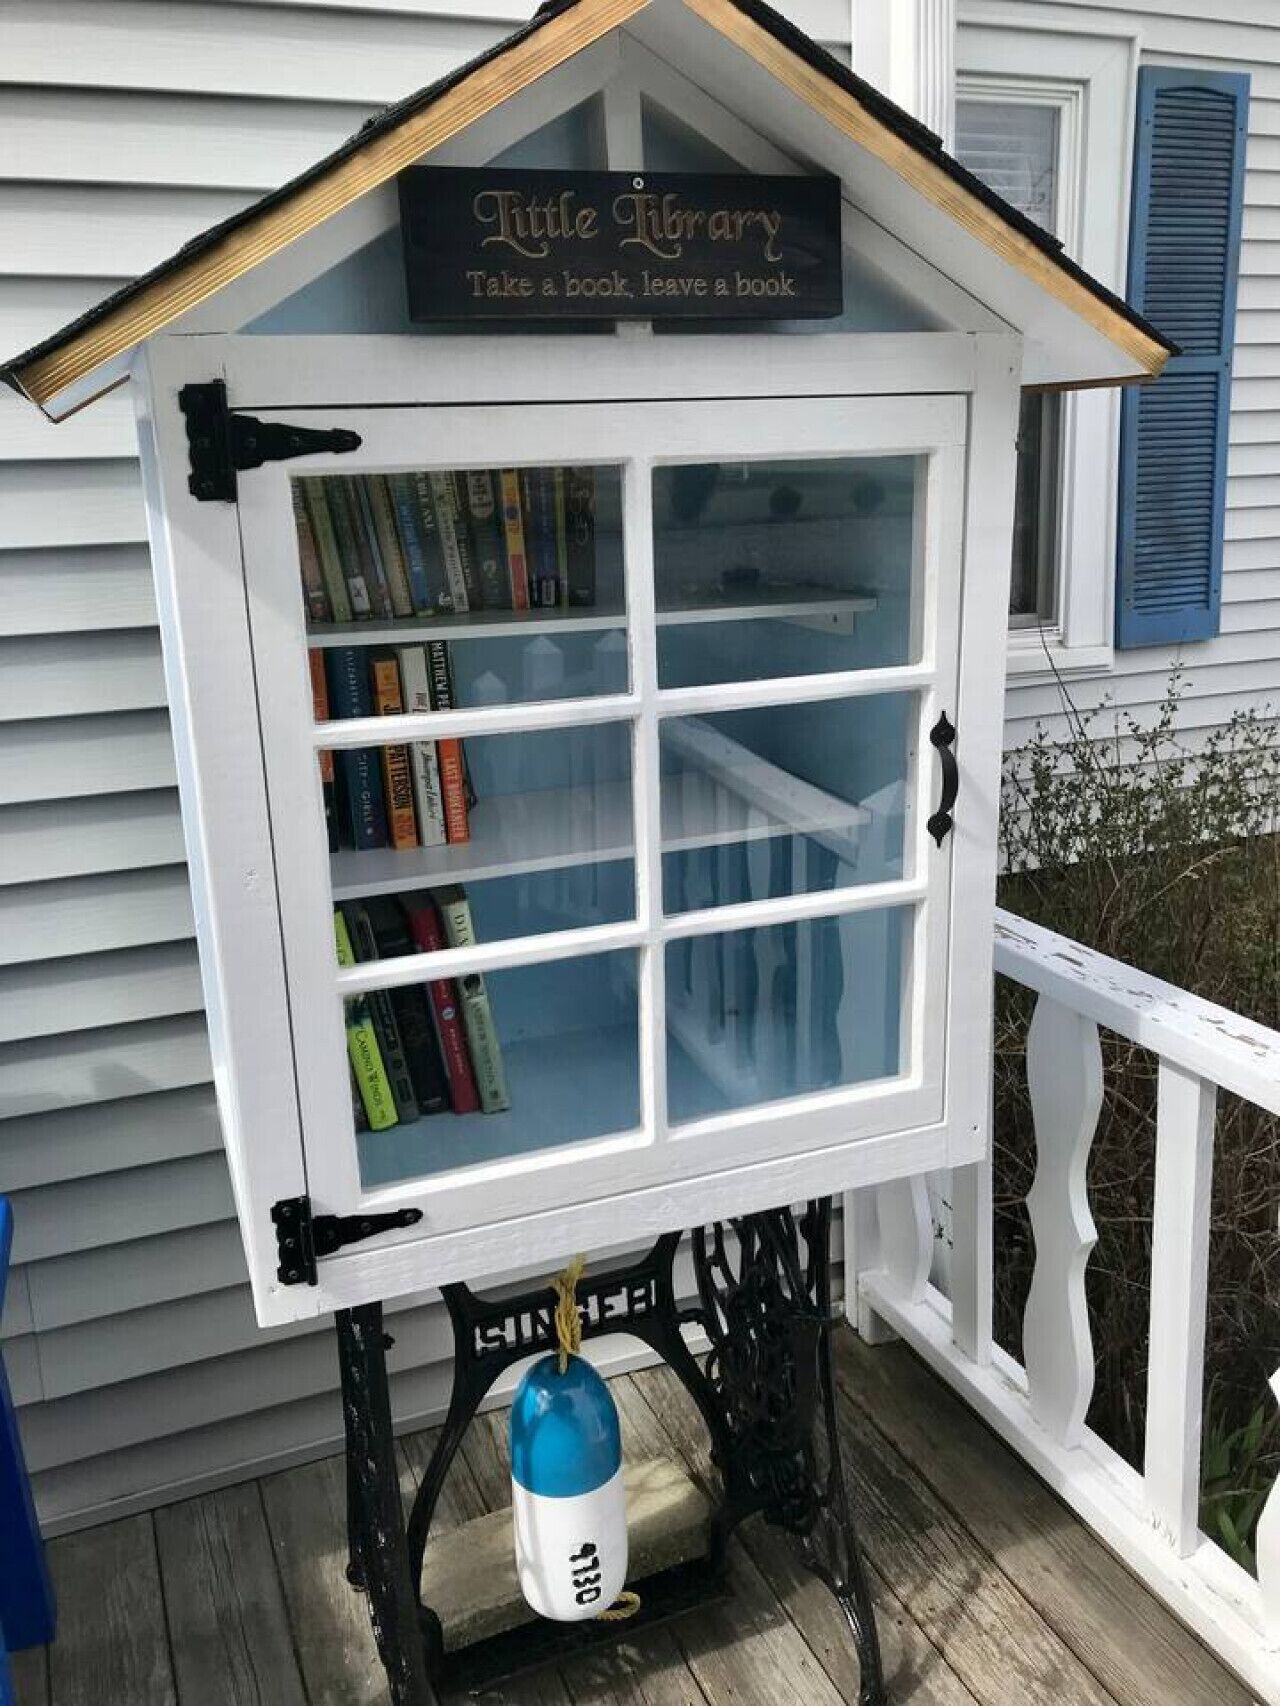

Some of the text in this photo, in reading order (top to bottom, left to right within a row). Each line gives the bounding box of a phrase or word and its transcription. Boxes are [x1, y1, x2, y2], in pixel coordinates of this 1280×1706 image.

[472, 191, 783, 262] Little Library
[466, 271, 796, 299] Take a book, leave a book
[568, 1542, 602, 1605] 9730
